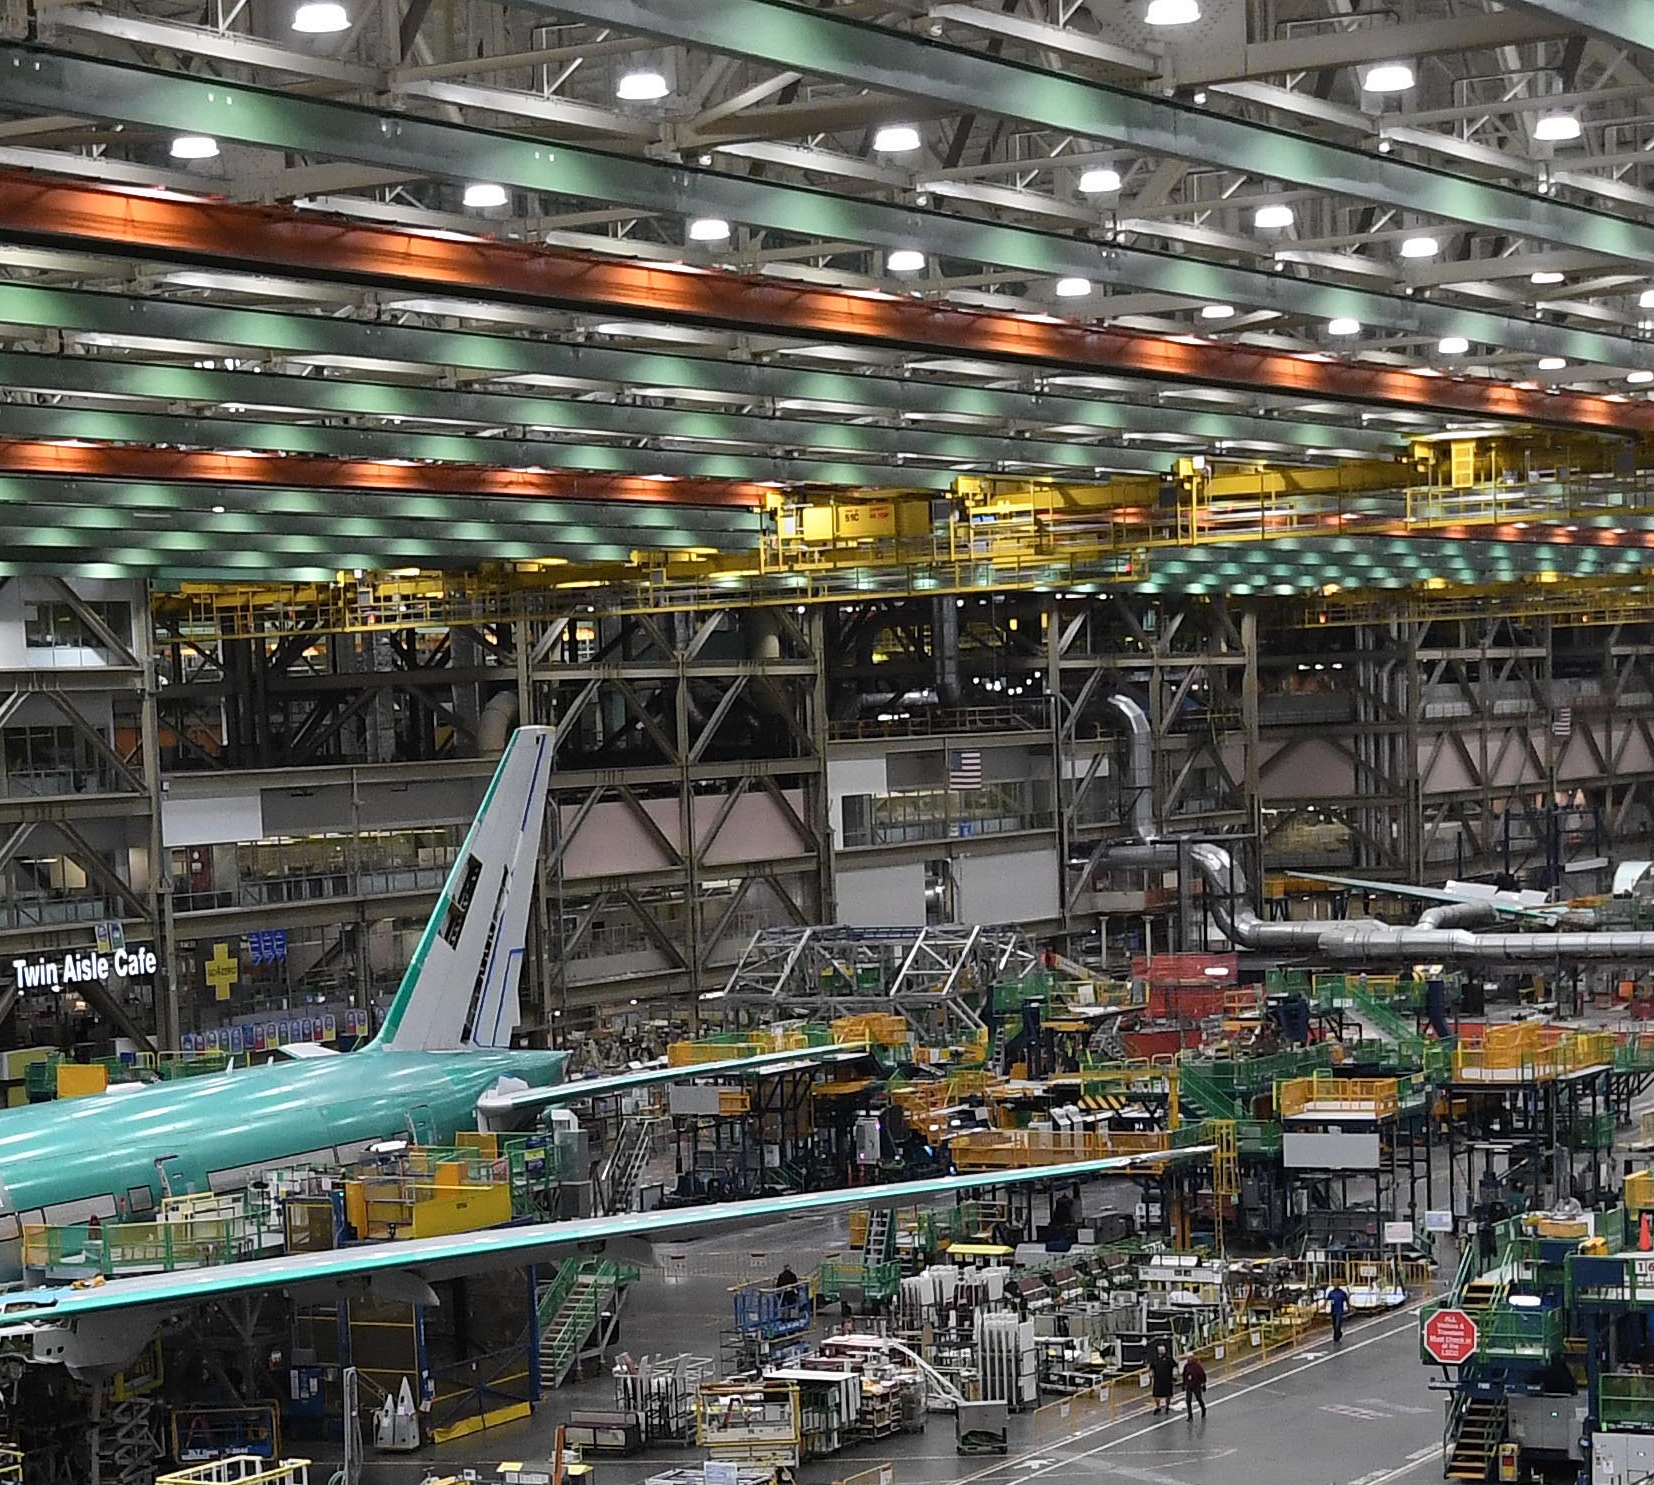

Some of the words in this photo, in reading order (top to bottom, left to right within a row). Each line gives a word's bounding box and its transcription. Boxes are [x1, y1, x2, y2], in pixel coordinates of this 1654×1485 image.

[13, 959, 58, 989] Twin
[63, 951, 109, 982] Aisle
[114, 947, 157, 977] Cafe
